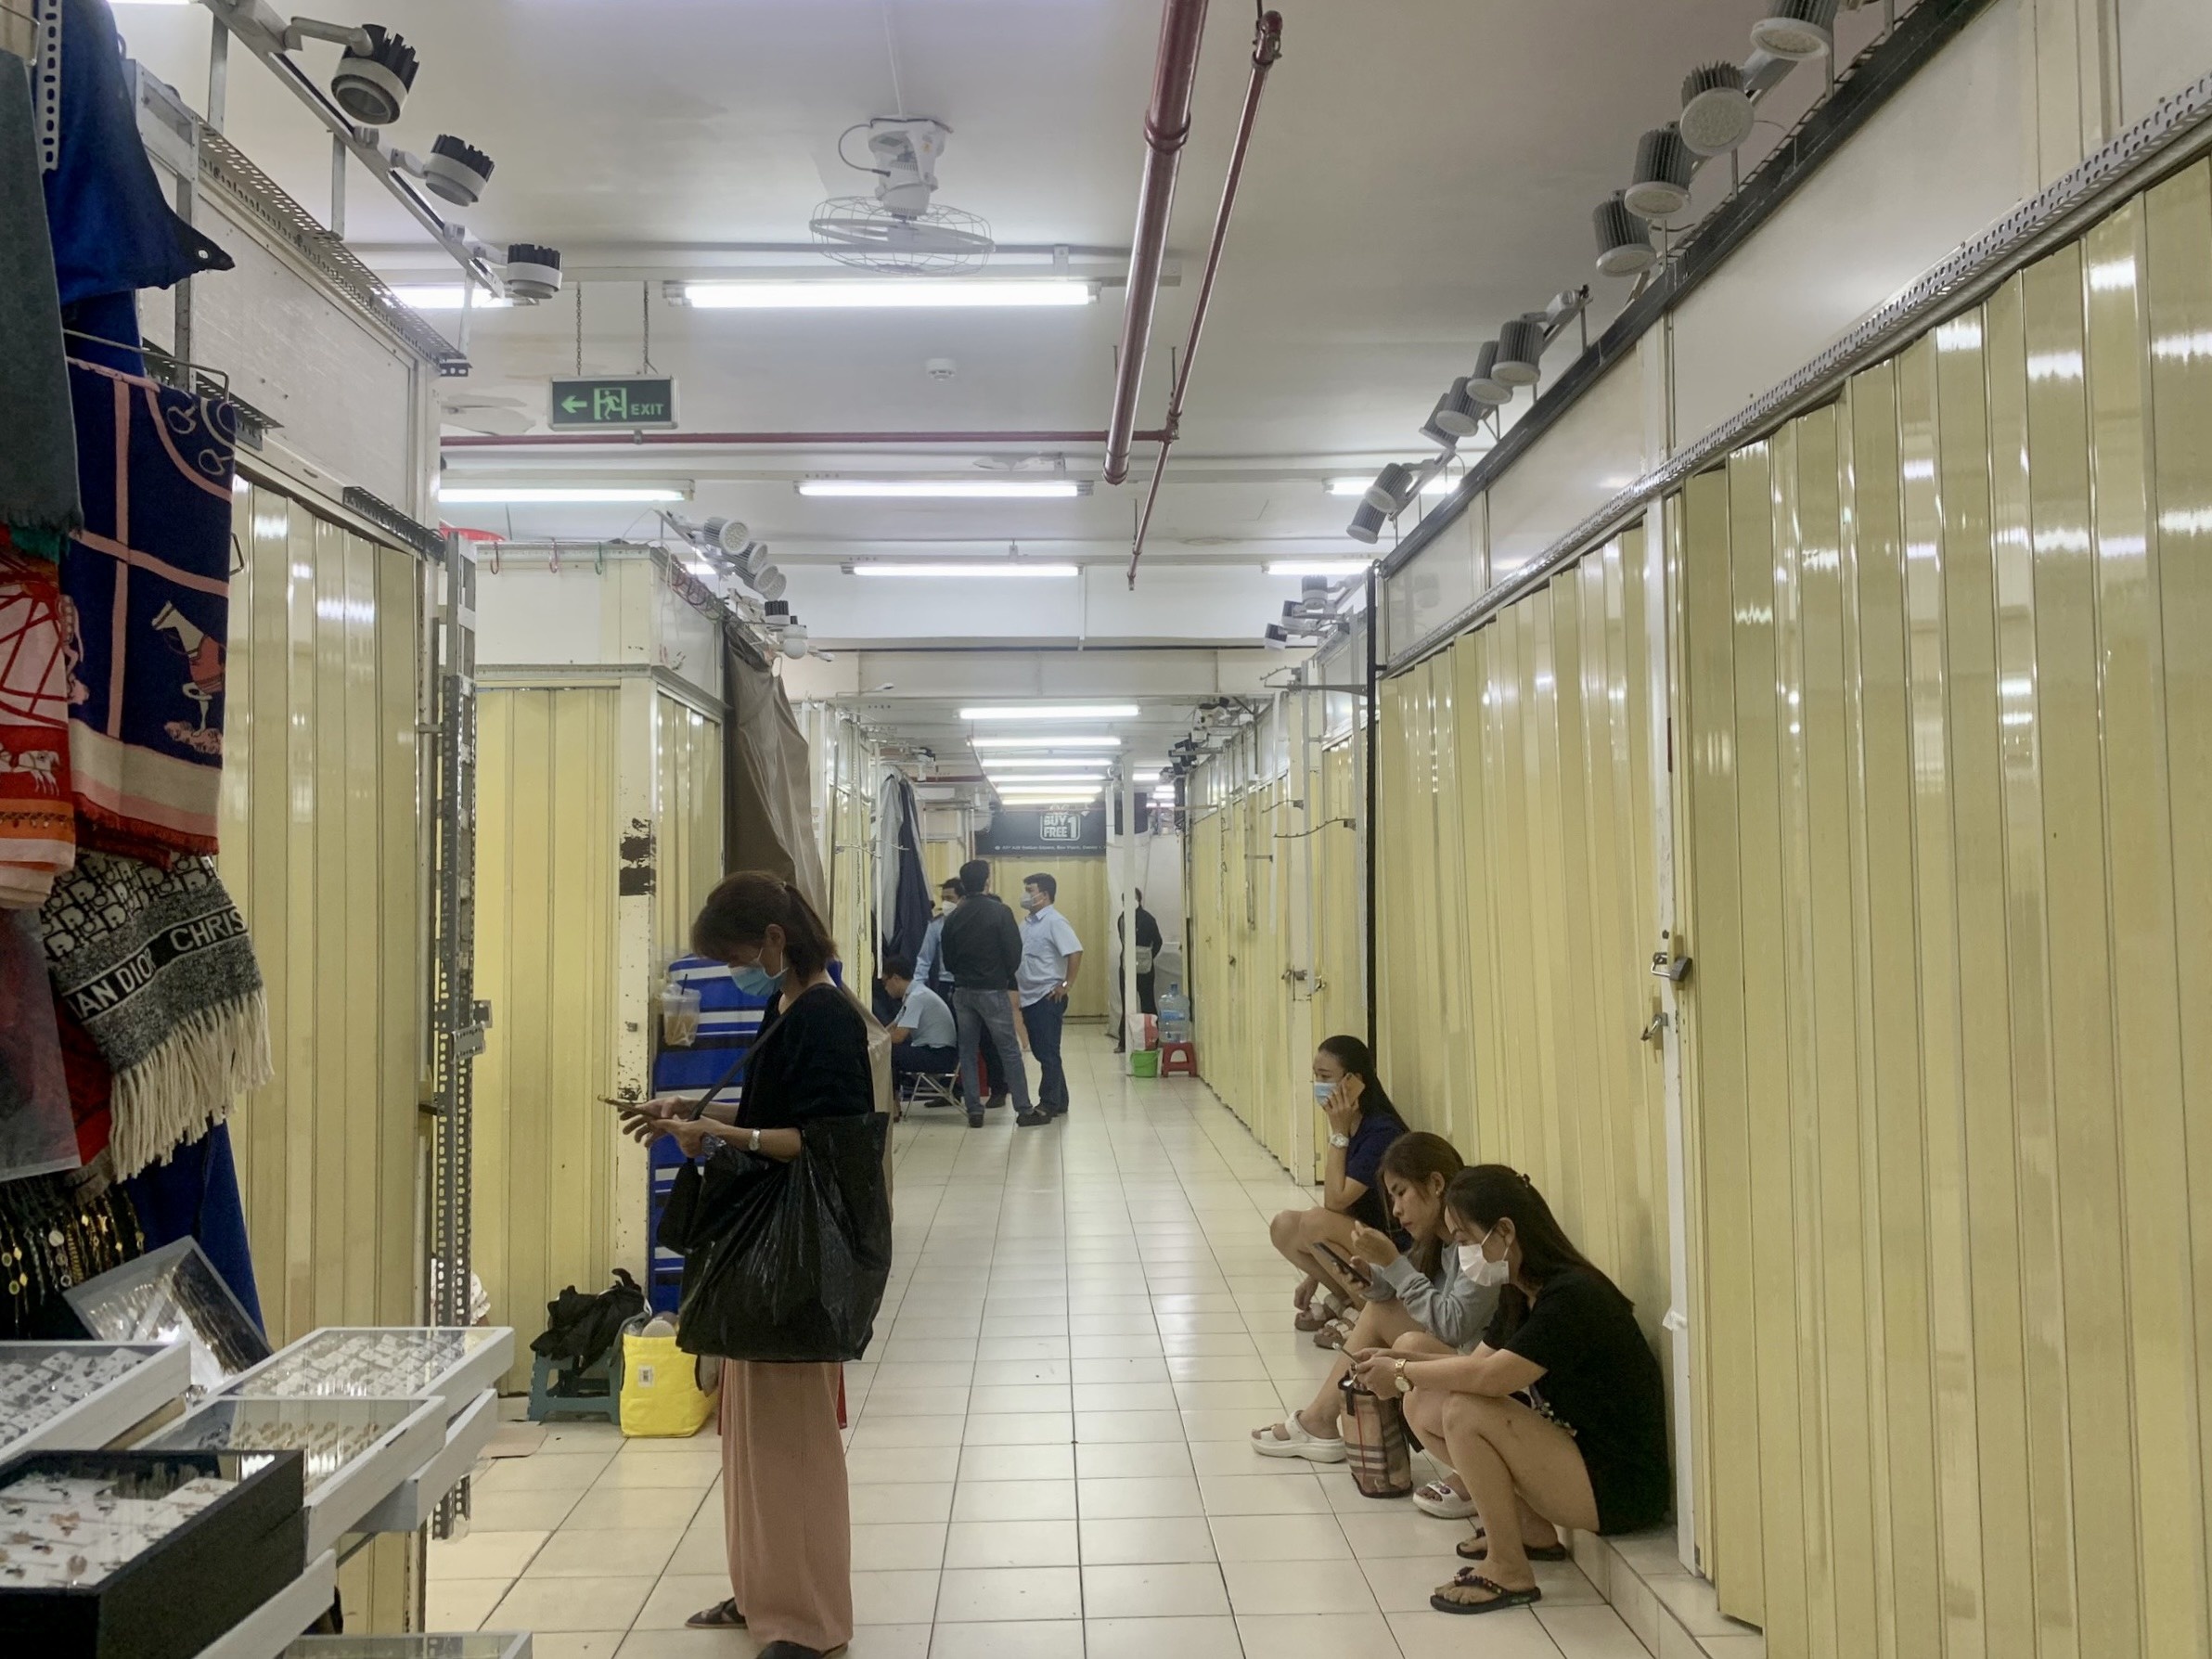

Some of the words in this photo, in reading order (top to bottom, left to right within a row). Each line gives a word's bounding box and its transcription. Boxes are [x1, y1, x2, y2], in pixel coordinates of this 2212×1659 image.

[630, 404, 664, 416] EXIT
[1044, 815, 1067, 826] BUY
[1068, 816, 1077, 839] 1
[1044, 826, 1068, 838] FREE
